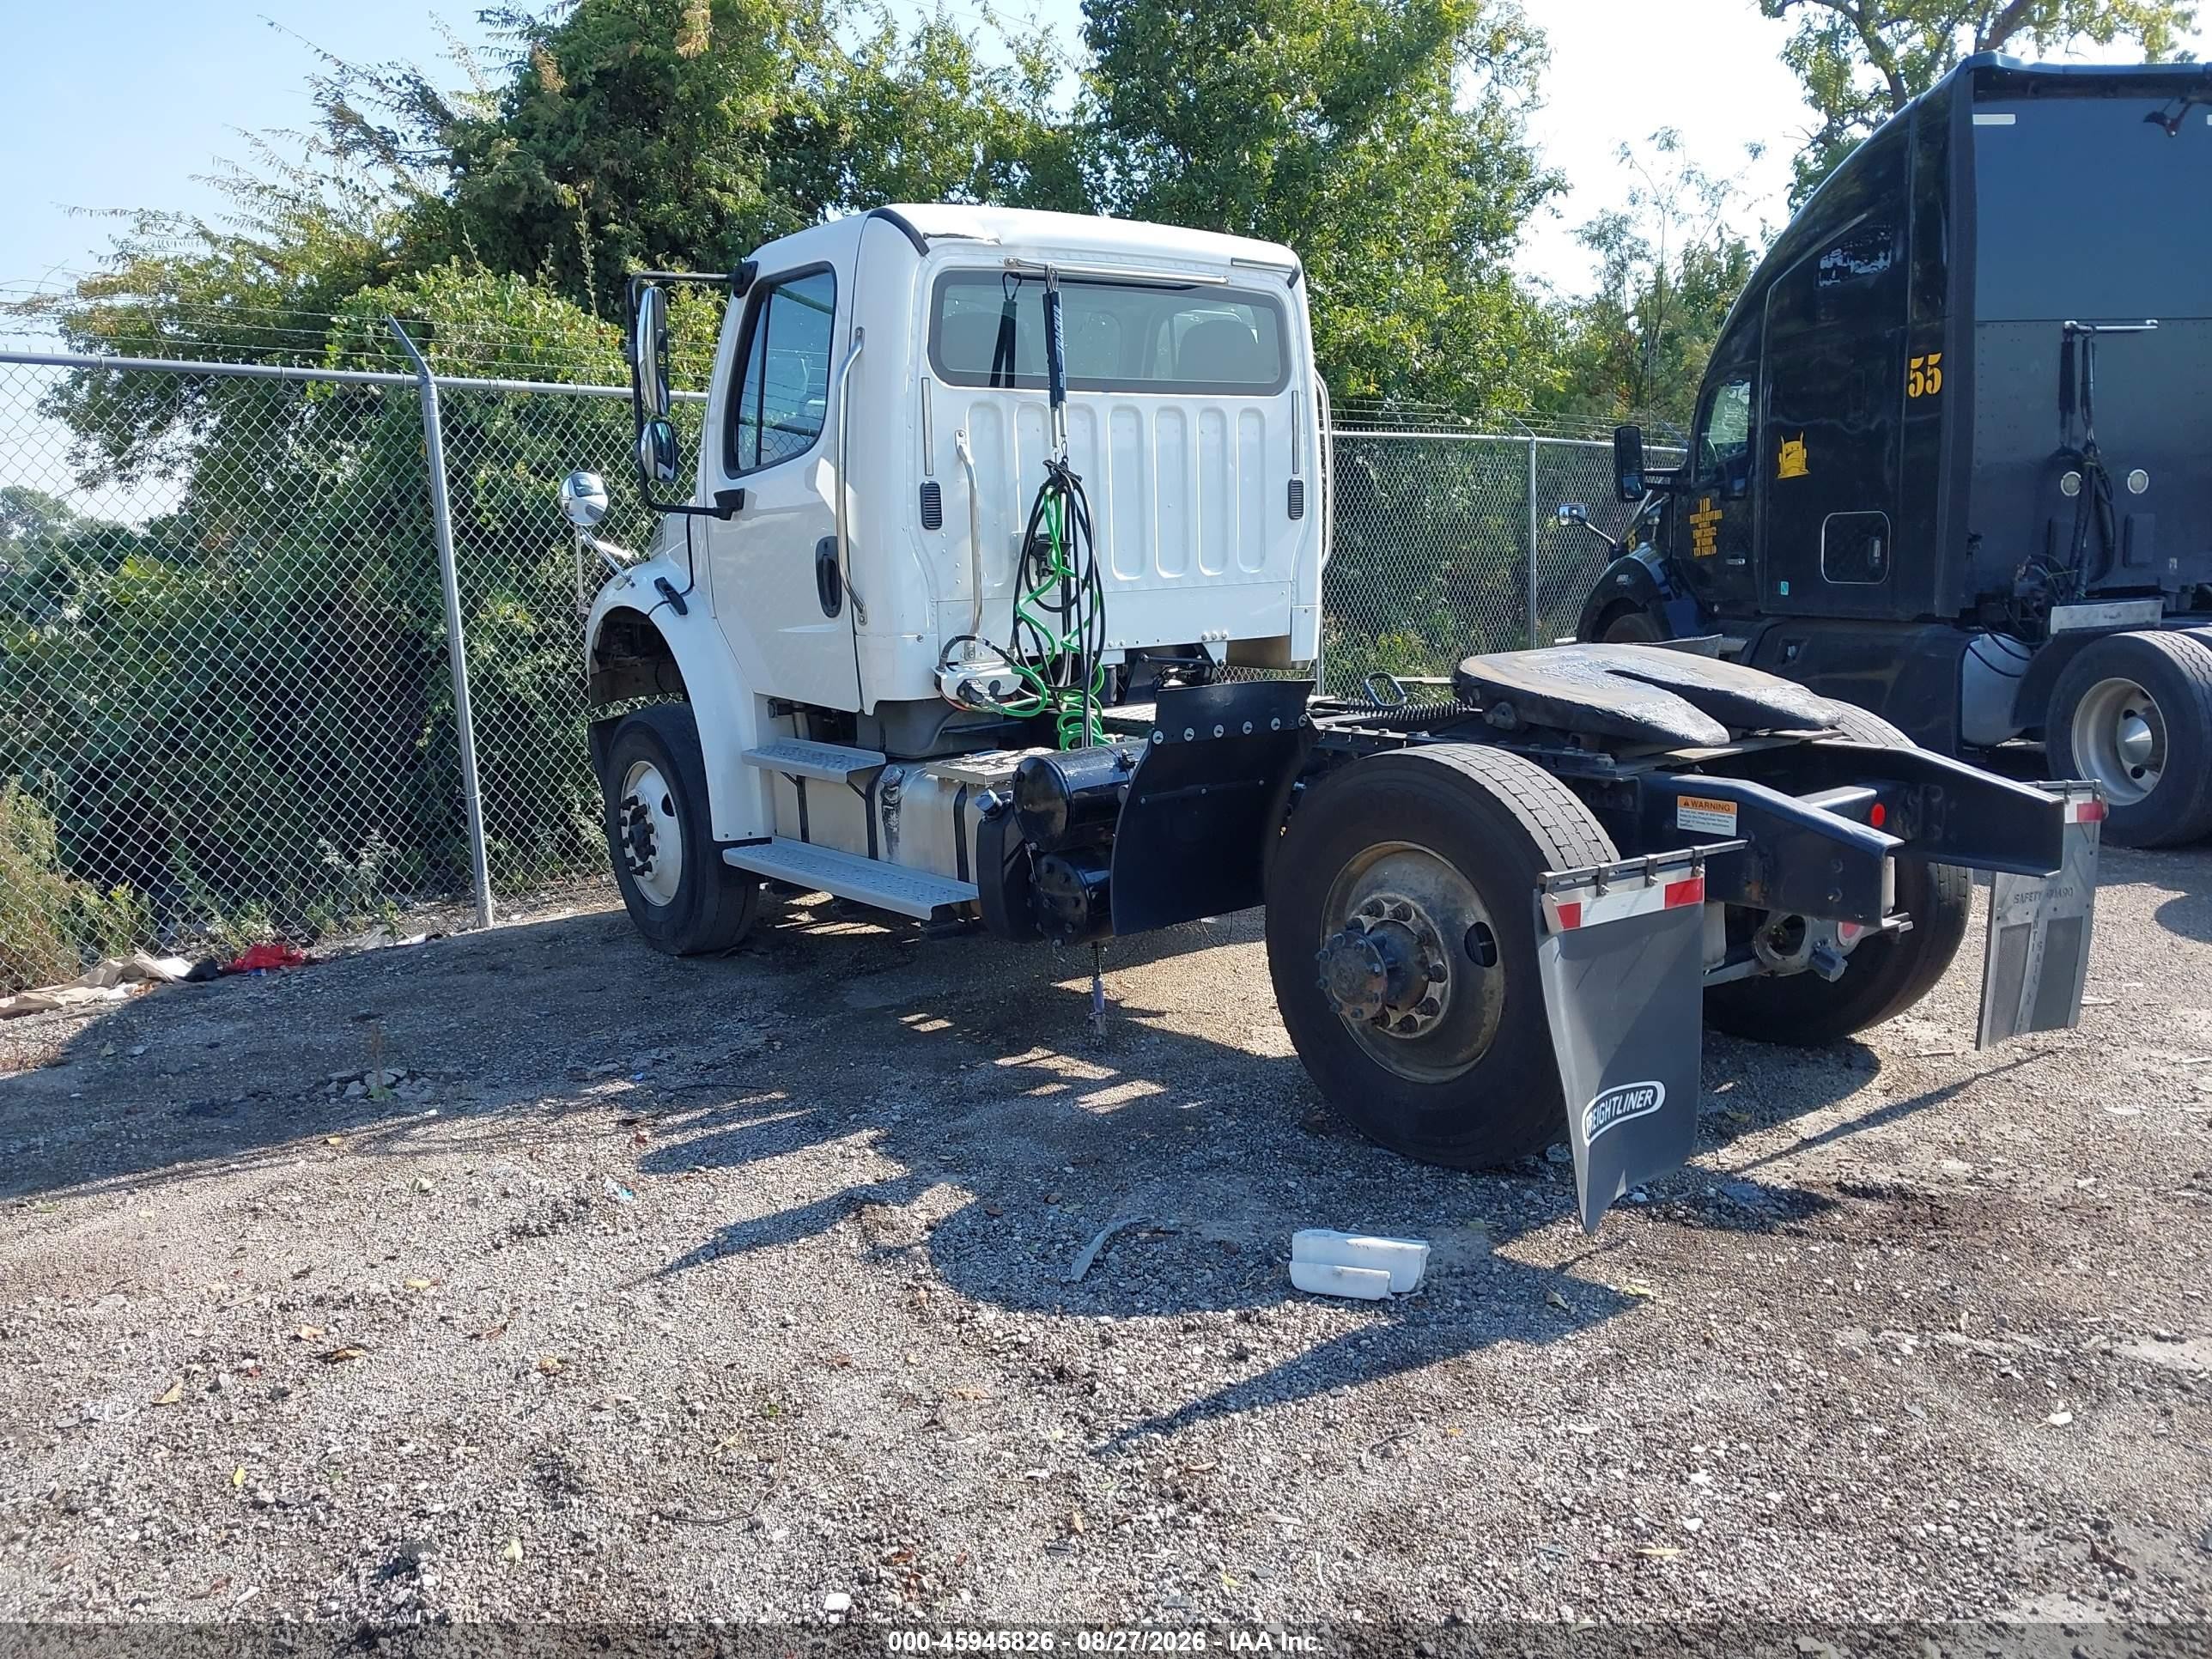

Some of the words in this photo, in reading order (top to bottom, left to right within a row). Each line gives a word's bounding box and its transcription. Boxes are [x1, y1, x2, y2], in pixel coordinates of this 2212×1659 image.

[1053, 304, 1065, 351] TRACKER
[1908, 352, 1942, 398] 55
[1691, 800, 1731, 811] WARNING
[1585, 1089, 1654, 1138] FREIGHTLINER
